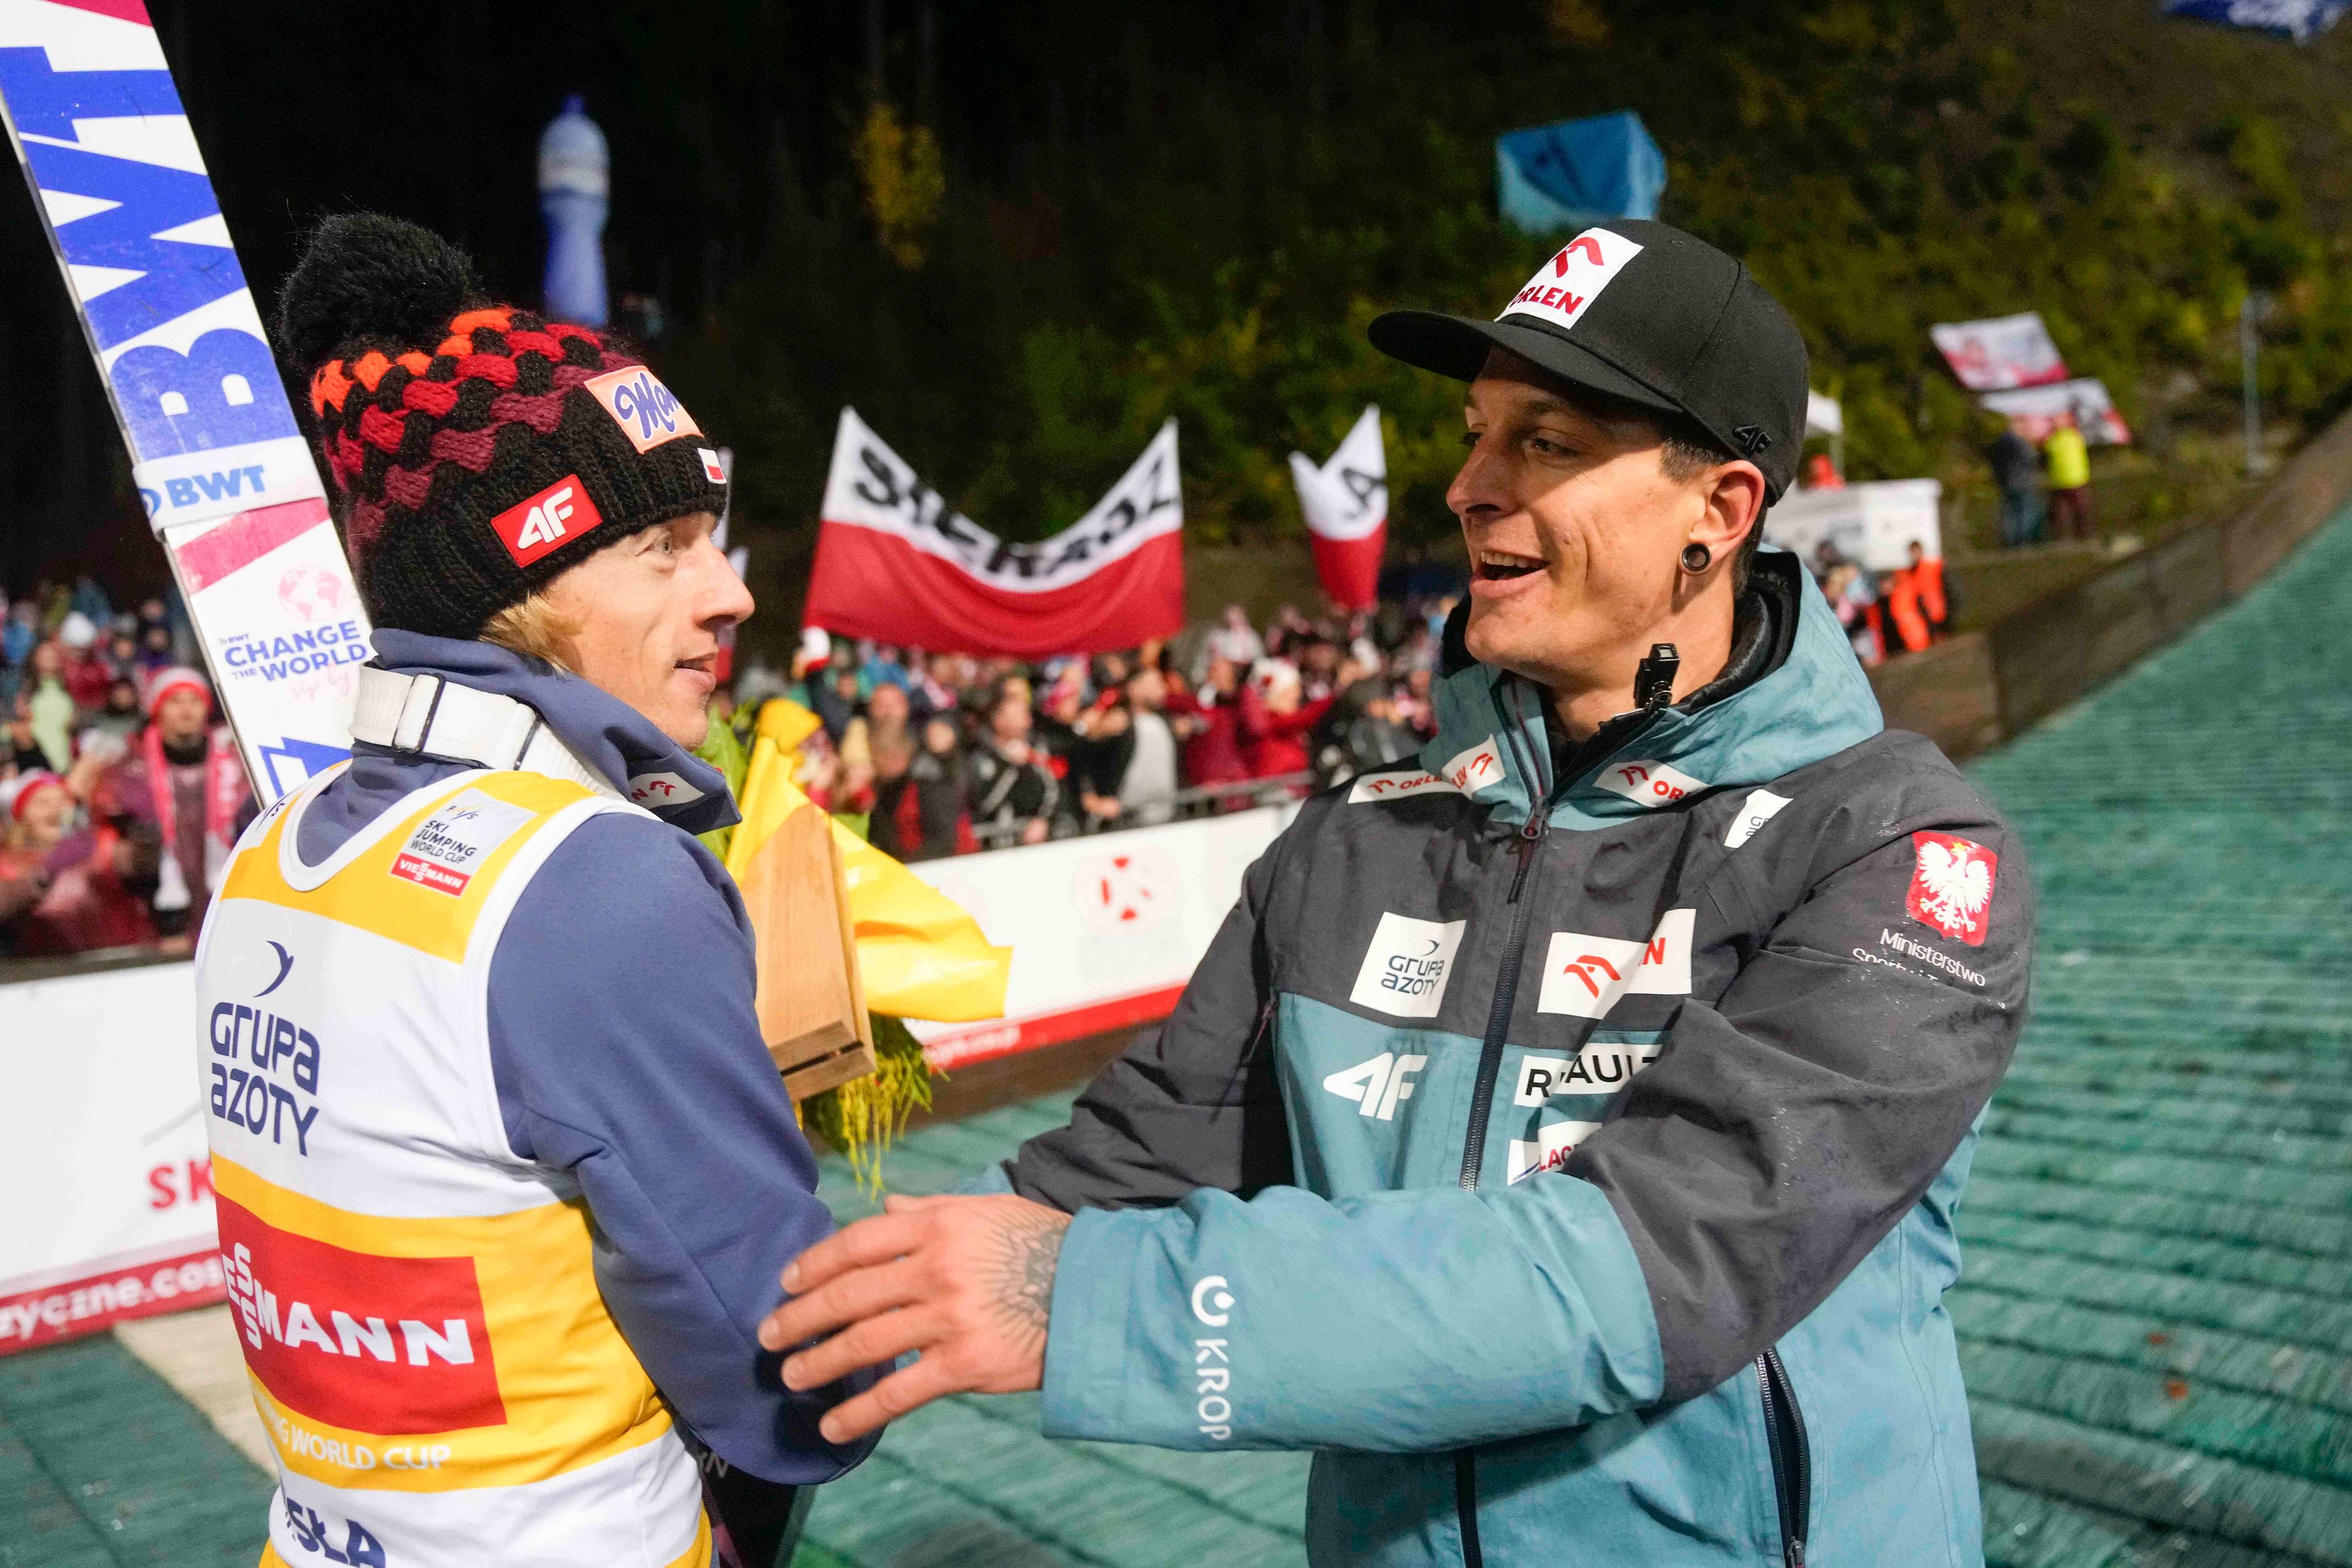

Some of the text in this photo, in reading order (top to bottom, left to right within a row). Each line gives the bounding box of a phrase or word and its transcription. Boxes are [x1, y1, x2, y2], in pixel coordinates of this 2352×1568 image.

[165, 464, 266, 509] BWT
[517, 487, 573, 549] 4F
[225, 620, 360, 667] CHANGE
[232, 644, 367, 681] THE WORLD
[416, 829, 477, 857] JUMPING
[425, 820, 449, 833] SKI
[410, 840, 466, 864] WORLD CUP
[1879, 928, 1986, 987] Ministerstwo
[1322, 1052, 1428, 1121] 4F
[222, 1242, 475, 1367] ESSMANN
[291, 1424, 451, 1469] WORLD CUP
